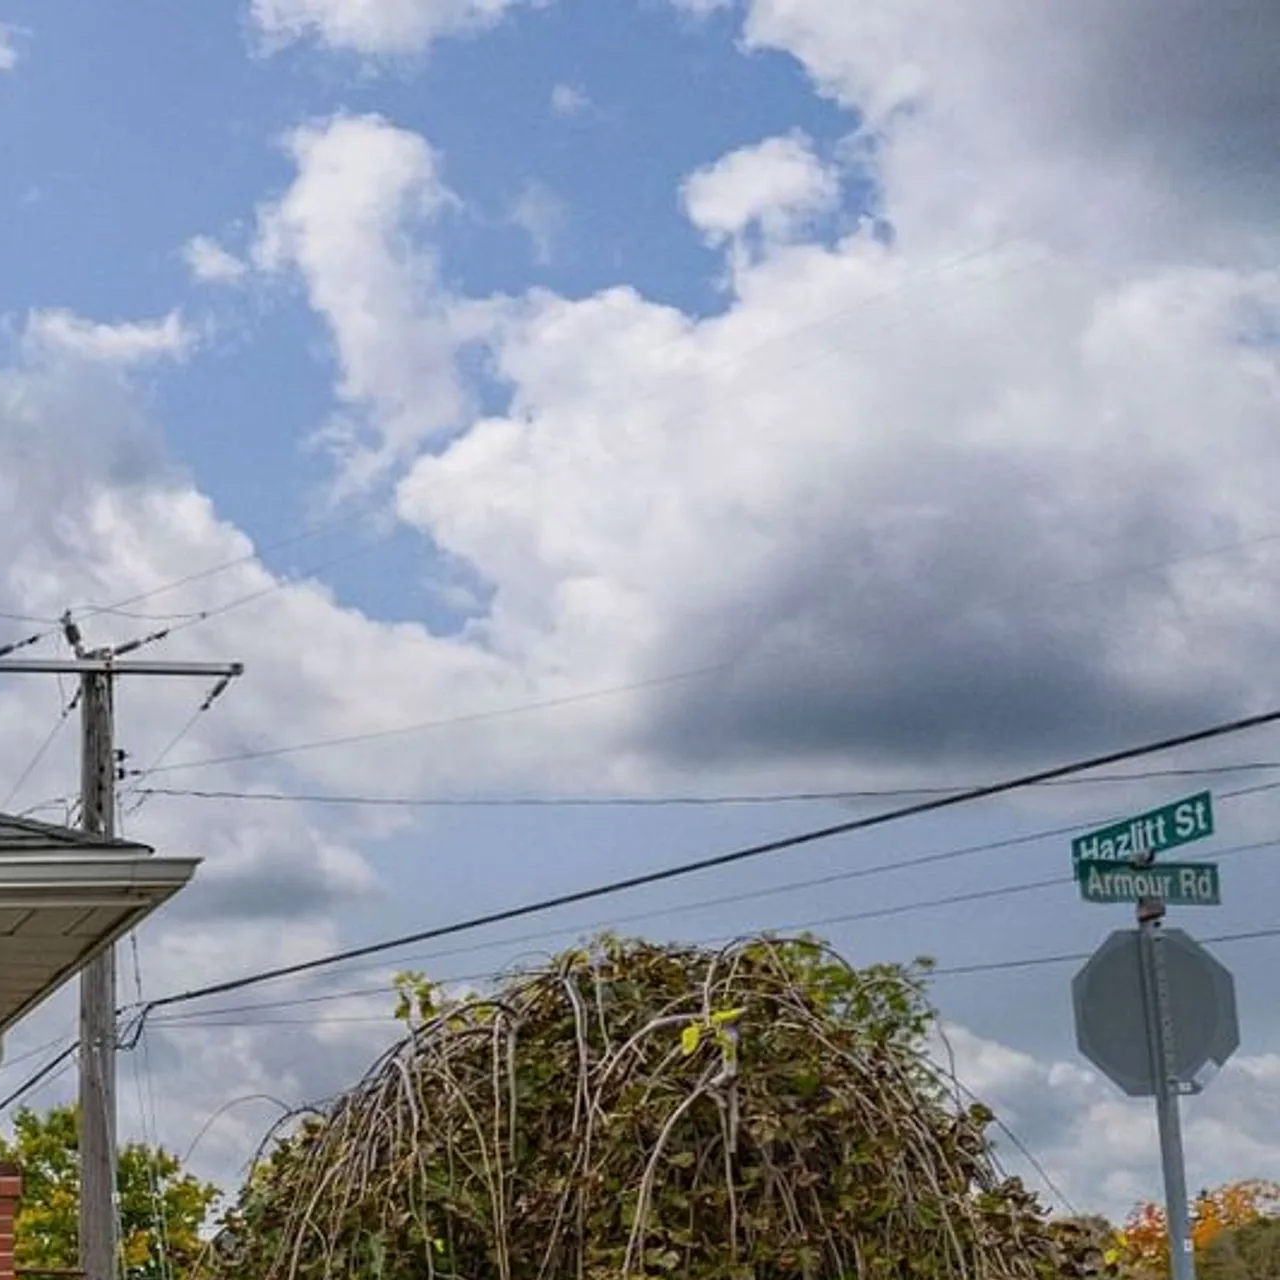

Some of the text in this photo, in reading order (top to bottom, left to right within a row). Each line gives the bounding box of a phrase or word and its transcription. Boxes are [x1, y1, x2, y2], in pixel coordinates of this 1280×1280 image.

[1079, 802, 1207, 860] Hazlitt St
[1088, 866, 1212, 899] Armour Rd
